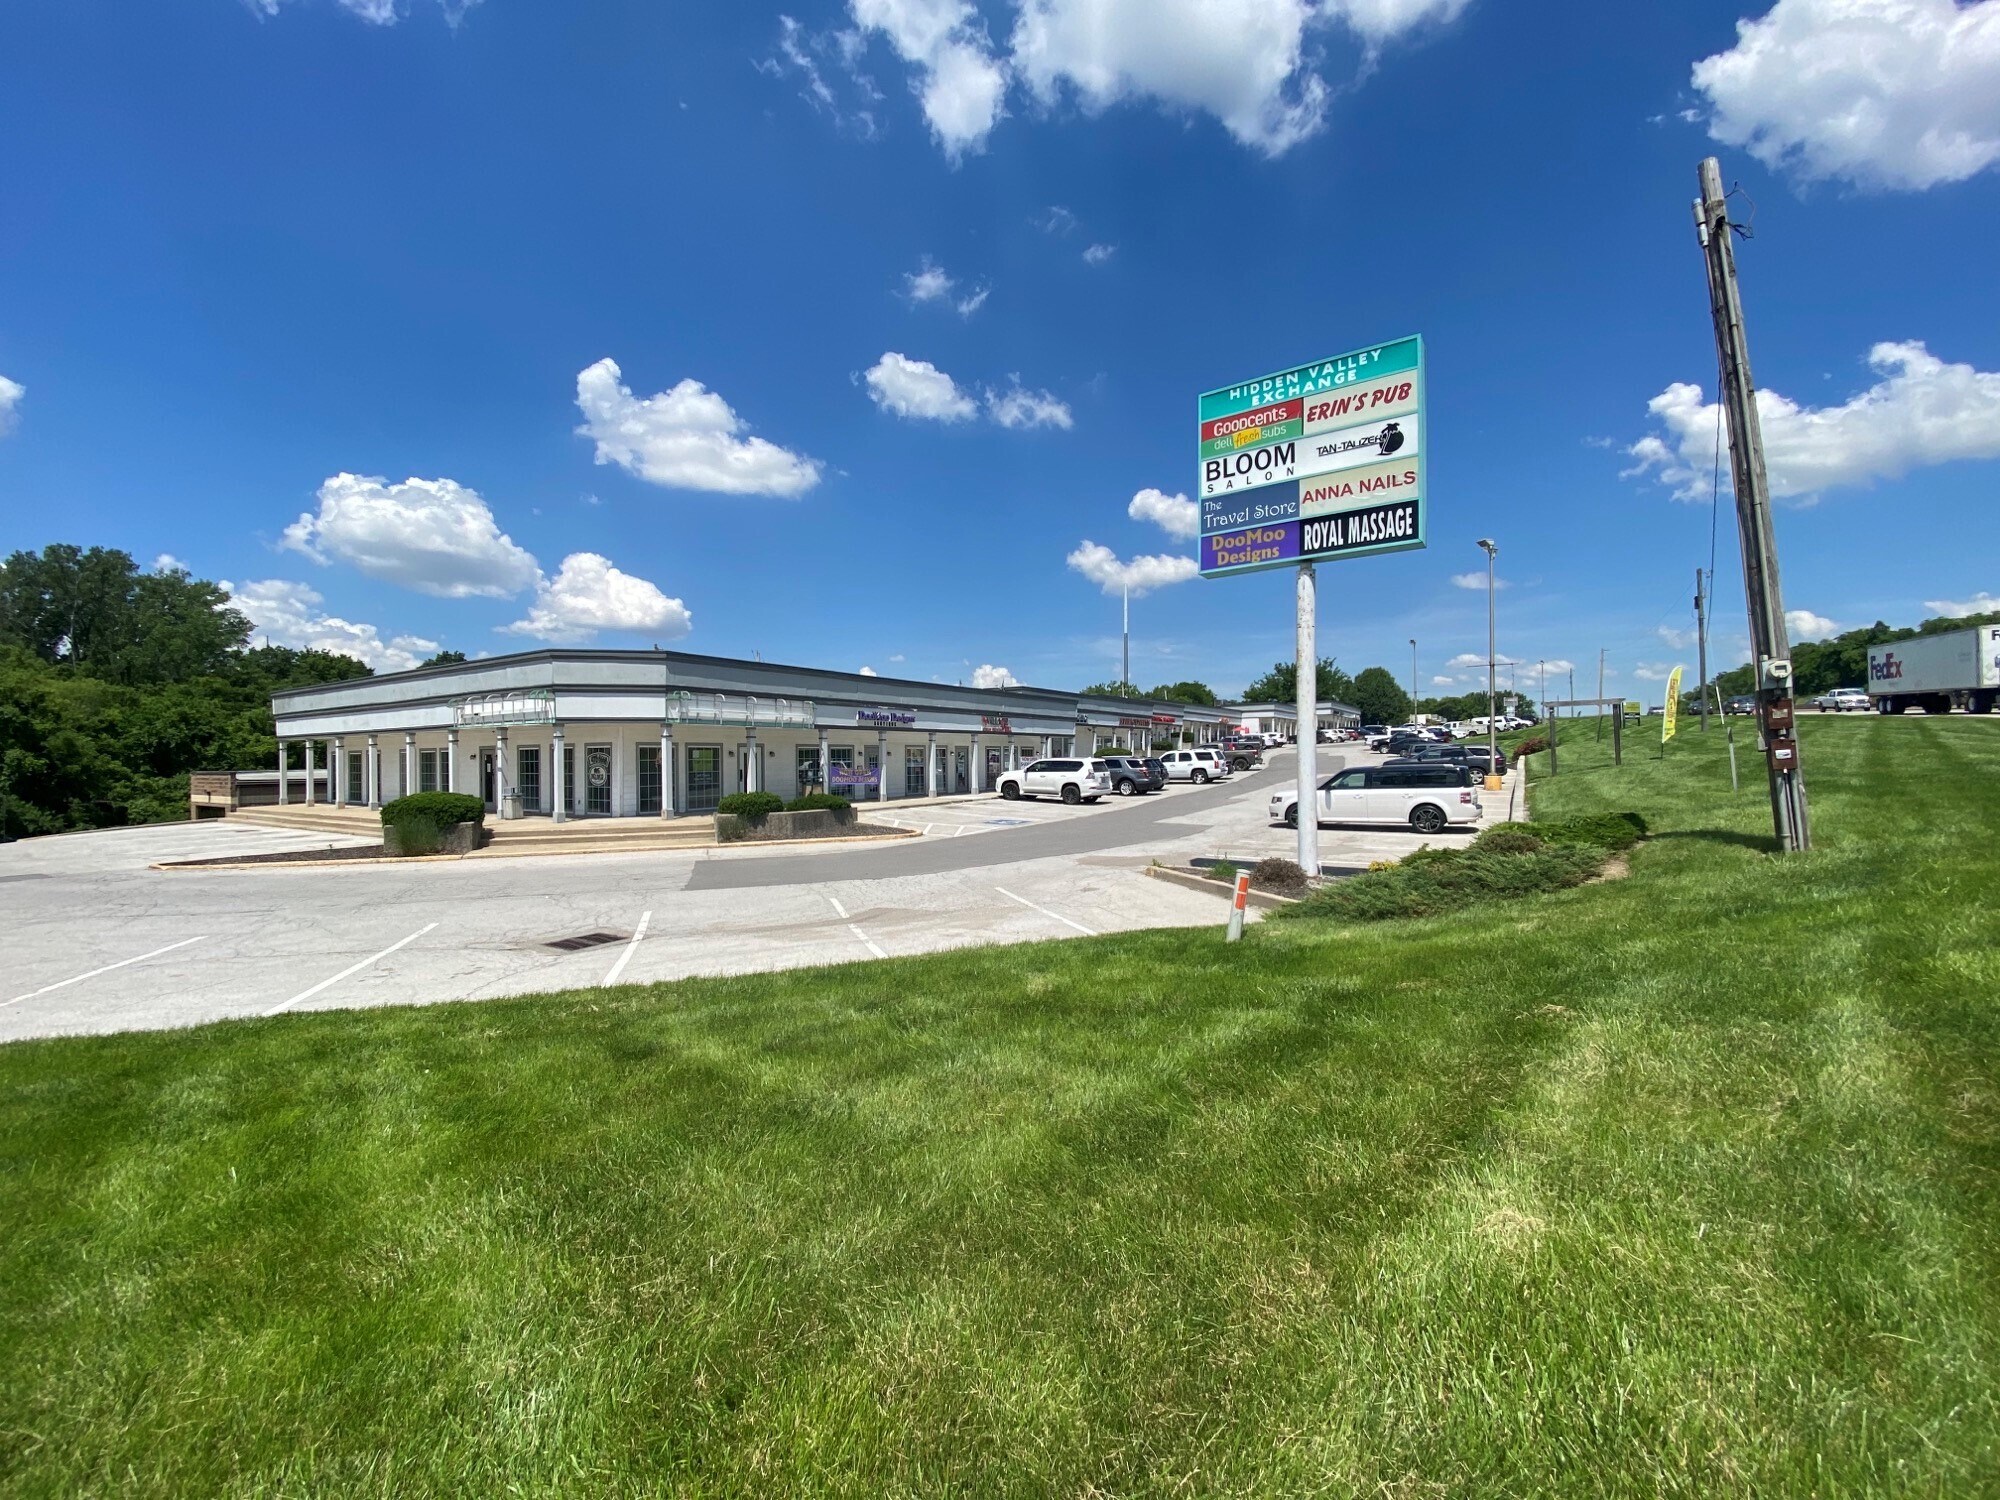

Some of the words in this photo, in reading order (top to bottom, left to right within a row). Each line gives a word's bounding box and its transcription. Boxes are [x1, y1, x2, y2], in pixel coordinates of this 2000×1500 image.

[1229, 372, 1299, 400] HIDDEN
[1308, 349, 1381, 379] VALLEY
[1251, 370, 1357, 407] EXCHANGE
[1307, 392, 1368, 422] ERIN'S
[1371, 382, 1412, 408] PUB
[1214, 437, 1233, 450] deli
[1235, 428, 1260, 447] fresh
[1262, 425, 1287, 439] subs
[1206, 442, 1296, 482] BLOOM
[1207, 466, 1295, 493] SALON
[1302, 482, 1354, 504] ANNA
[1359, 470, 1416, 494] NAILS
[1204, 501, 1222, 512] The
[1204, 507, 1249, 528] Travel
[1253, 502, 1297, 519] Store
[1212, 529, 1286, 551] DooMoo
[1304, 519, 1344, 551] ROYAL
[1347, 507, 1413, 544] MASSAGE
[1217, 546, 1280, 566] Designs
[1870, 652, 1902, 681] FedEx
